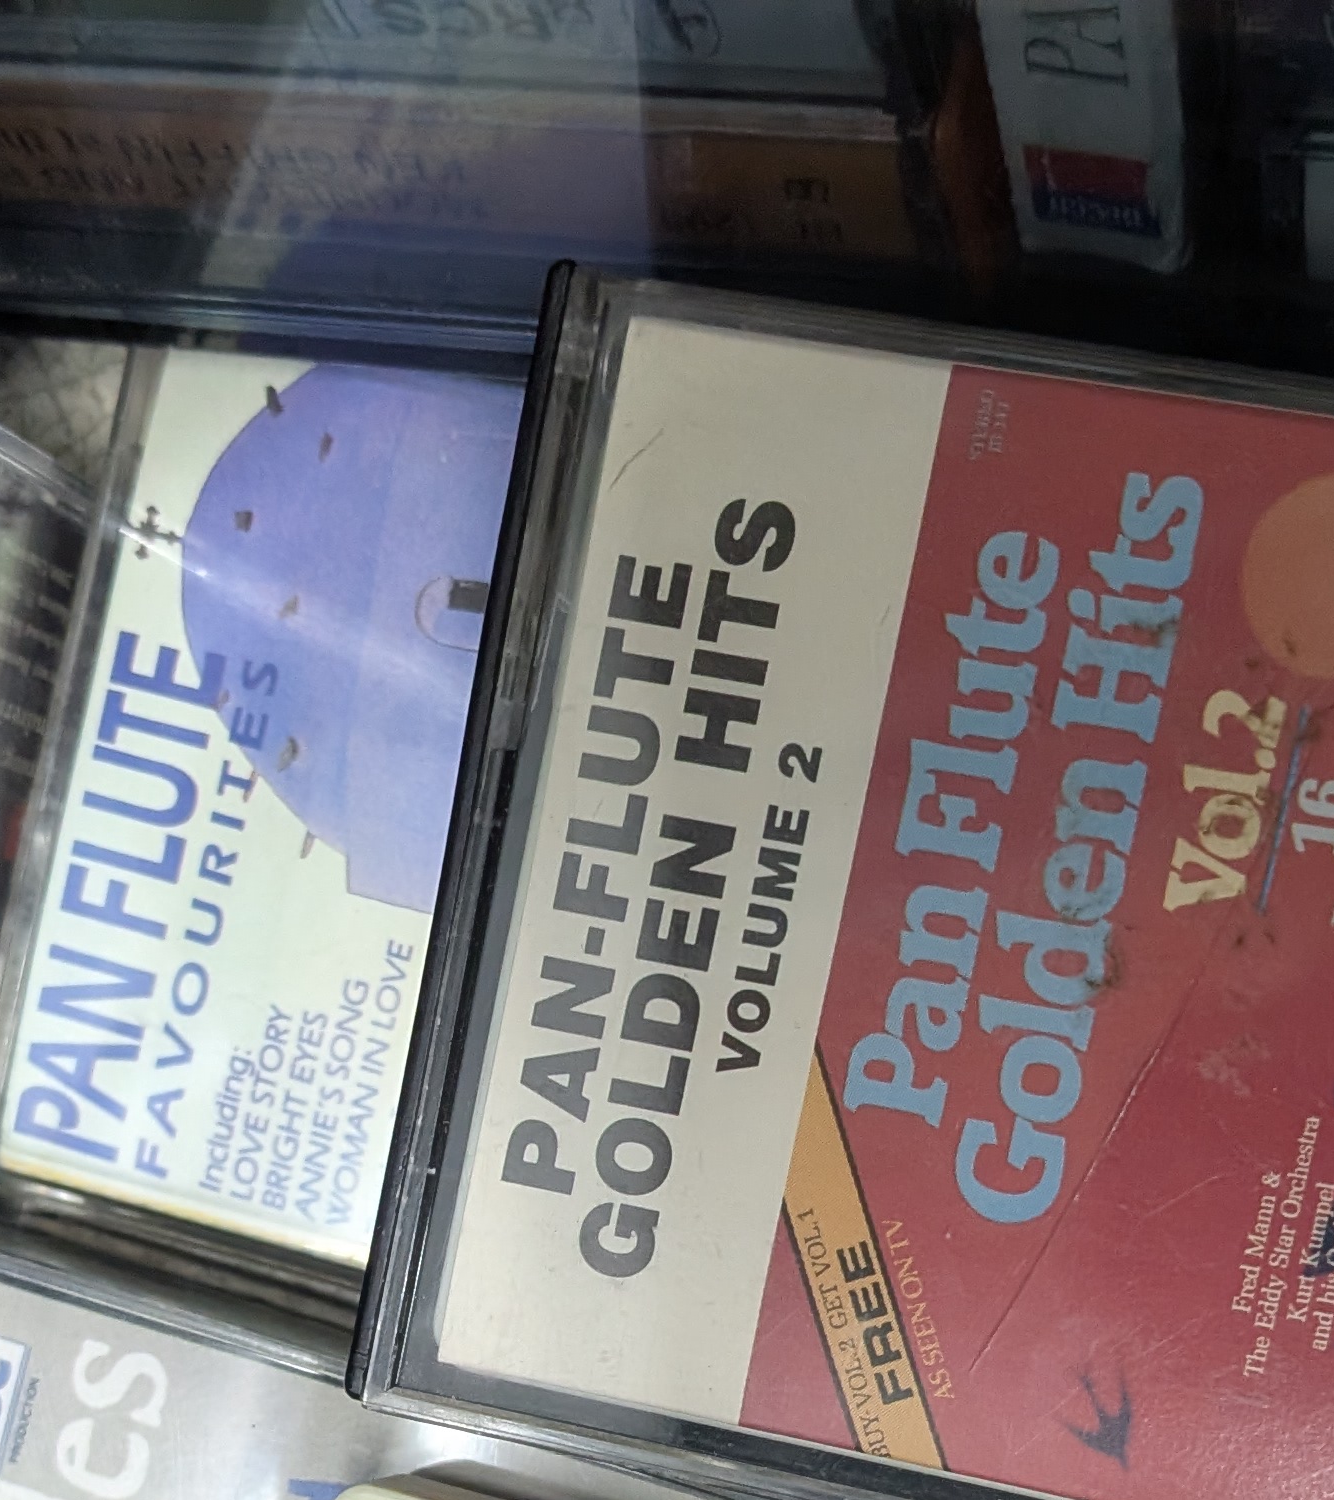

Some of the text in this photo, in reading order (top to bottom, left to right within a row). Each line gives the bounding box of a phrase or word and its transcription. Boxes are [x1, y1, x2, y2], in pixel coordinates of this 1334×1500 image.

[13, 630, 223, 1163] PAN FLUTE
[134, 662, 283, 1180] FAVOURITES
[498, 554, 698, 1196] PAN-FLUTE
[581, 495, 801, 1279] GOLDEN HITS
[712, 738, 825, 1079] VOLUME 2
[844, 528, 1059, 1128] Pan Flute
[955, 469, 1205, 1226] Golden Hits
[195, 1044, 259, 1193] Including:
[226, 1003, 296, 1201] LOVE STORY
[257, 1008, 330, 1212] BRIGHT EYES
[289, 975, 372, 1221] ANNIE'S SONG
[321, 937, 415, 1229] WOMAN IN LOVE
[820, 1281, 847, 1329] GET
[837, 1240, 913, 1405] FREE
[883, 1219, 955, 1397] AS SEEN ON TV
[1231, 1169, 1282, 1314] Fred Mann &
[1242, 1112, 1321, 1379] The Eddy Star Orchestra
[1286, 1272, 1316, 1322] Kurt
[1307, 1309, 1334, 1351] and
[7, 1374, 42, 1465] PRODUCTION
